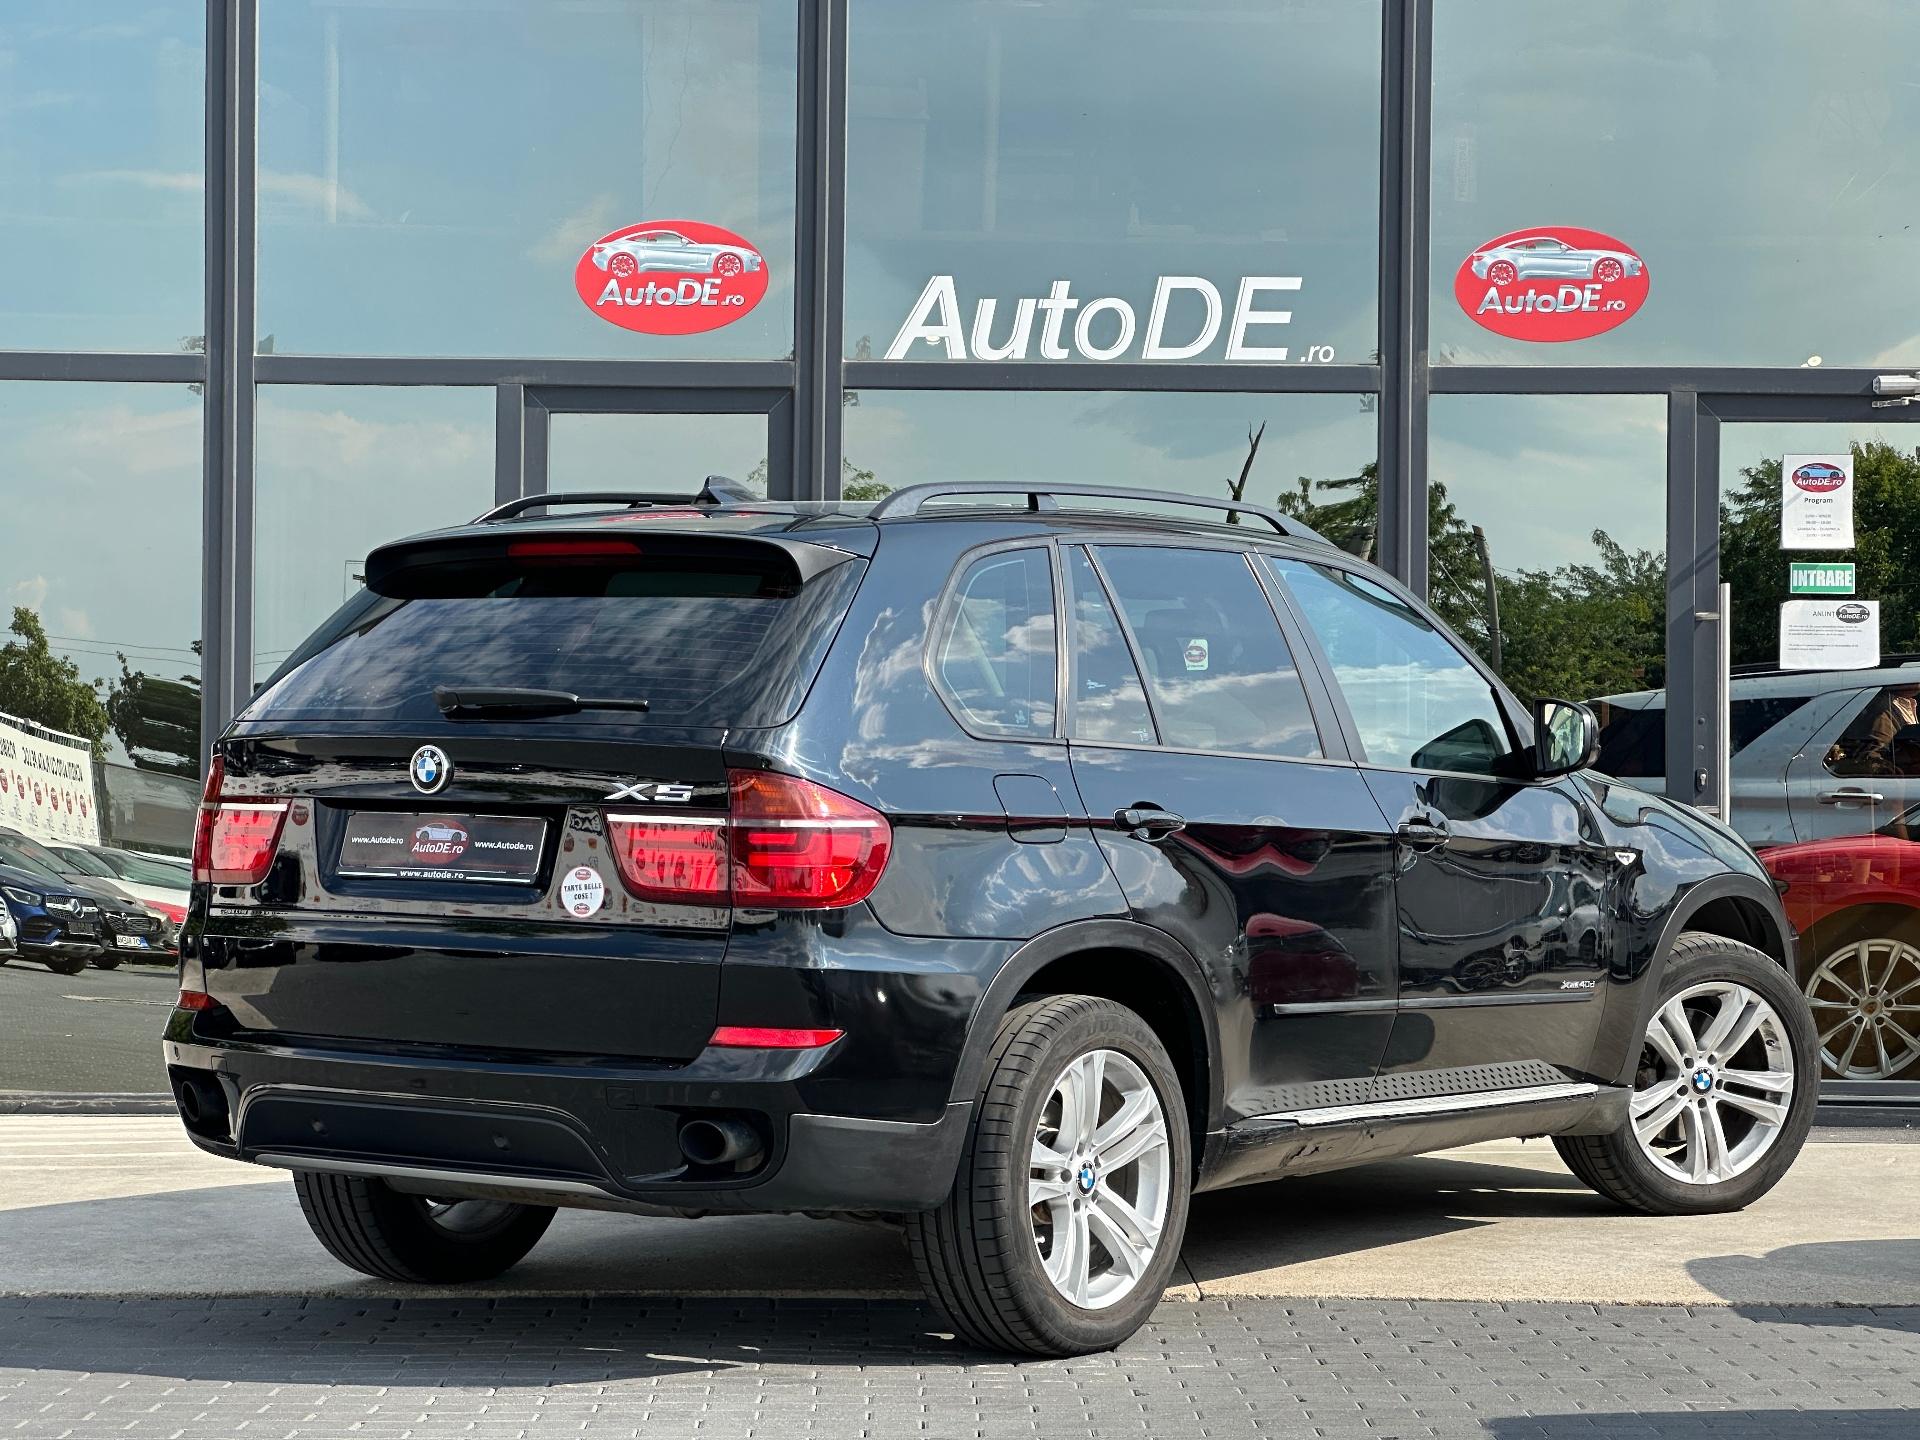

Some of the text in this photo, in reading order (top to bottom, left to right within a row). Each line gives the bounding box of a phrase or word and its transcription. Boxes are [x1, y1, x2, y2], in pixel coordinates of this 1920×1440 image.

[1796, 478, 1842, 486] AutoDE.ro
[1792, 569, 1853, 586] INTRARE
[604, 783, 694, 801] X5
[351, 836, 404, 845] www.Autode.ro
[412, 842, 464, 854] AutoDE.ro
[474, 841, 534, 851] www.Autode.ro
[400, 870, 464, 879] www.autode.ro
[584, 882, 602, 891] BELLE
